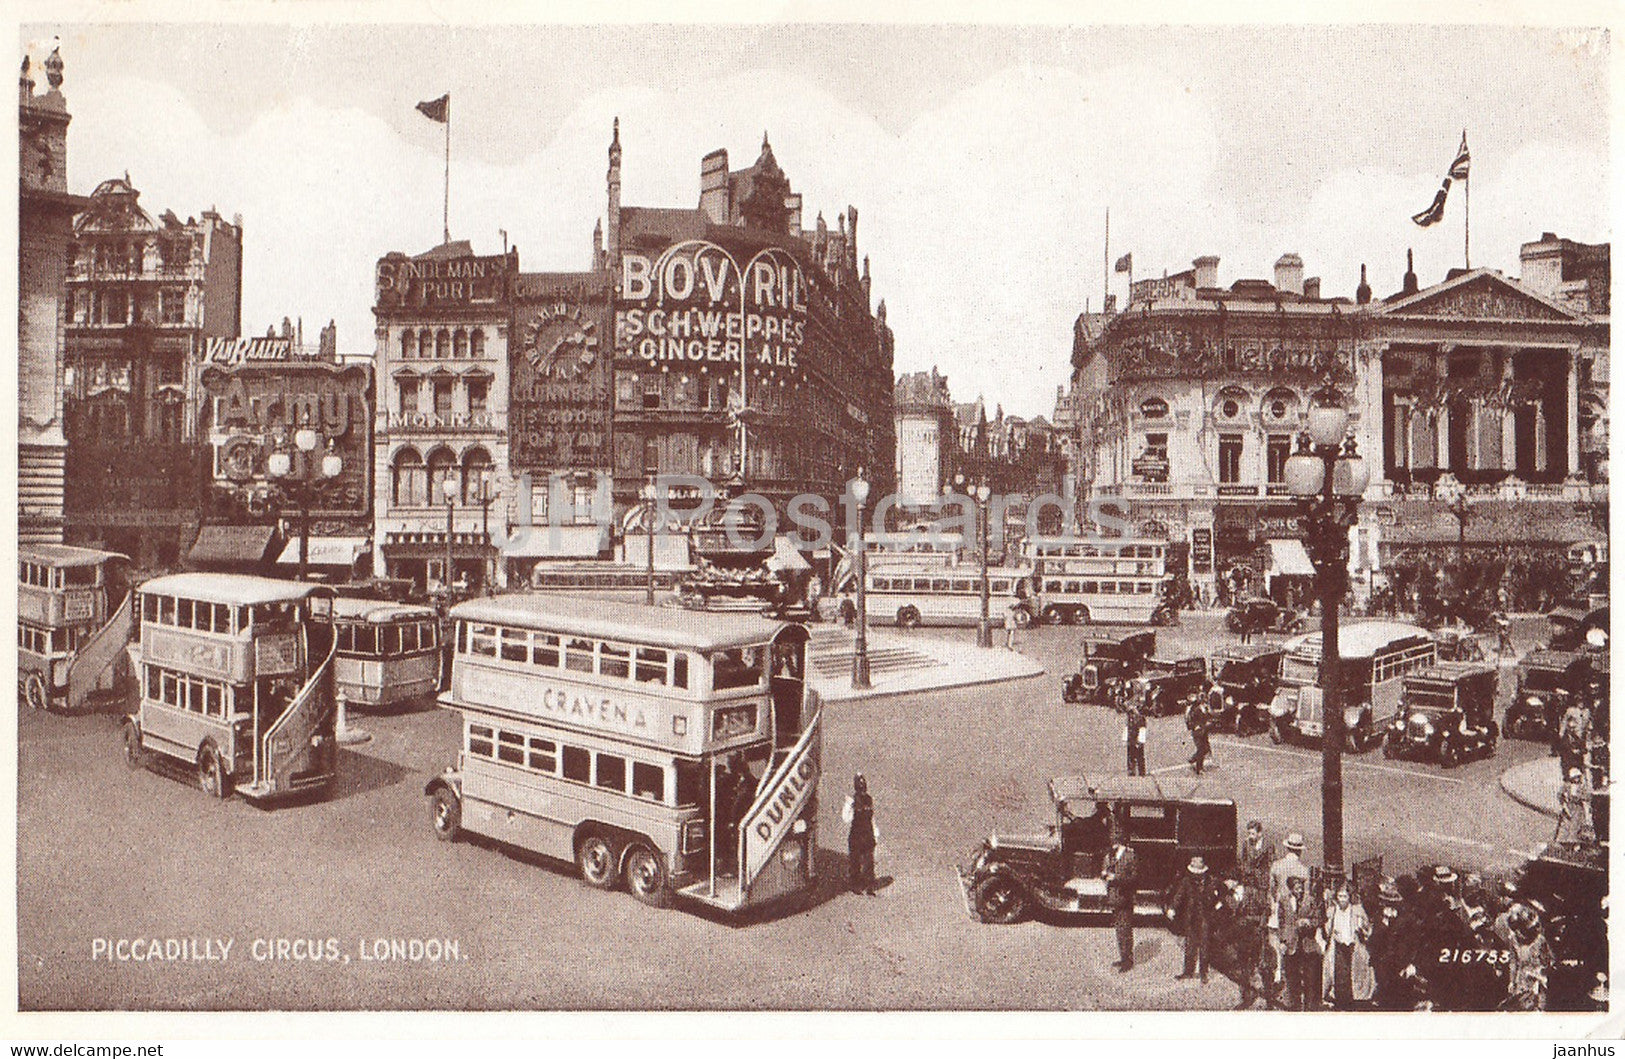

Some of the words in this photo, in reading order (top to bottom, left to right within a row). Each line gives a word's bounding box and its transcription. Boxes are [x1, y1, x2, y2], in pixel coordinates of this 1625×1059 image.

[622, 254, 807, 314] BOVRIL
[639, 339, 740, 361] GINGER
[760, 344, 798, 368] ALE
[221, 377, 349, 438] Army
[543, 688, 627, 723] CRAVEN
[634, 711, 647, 729] A
